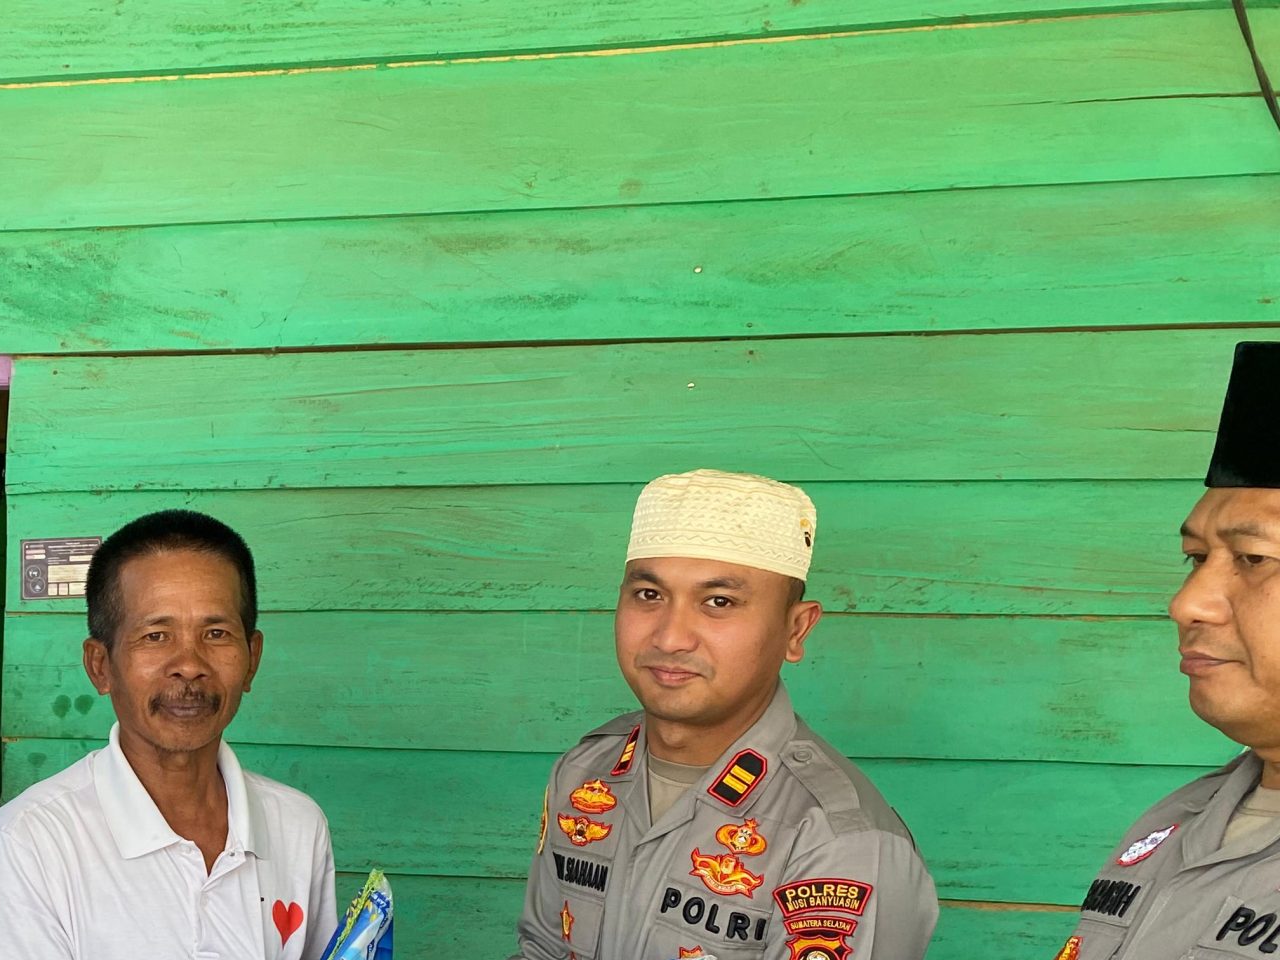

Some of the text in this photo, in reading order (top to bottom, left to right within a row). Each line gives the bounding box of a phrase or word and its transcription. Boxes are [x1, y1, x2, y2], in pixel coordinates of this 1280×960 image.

[786, 884, 858, 902] POLRES
[786, 896, 859, 912] MUSI BANYUASIN
[661, 887, 767, 940] POLRI
[790, 920, 851, 931] SUMATERA SELATAN
